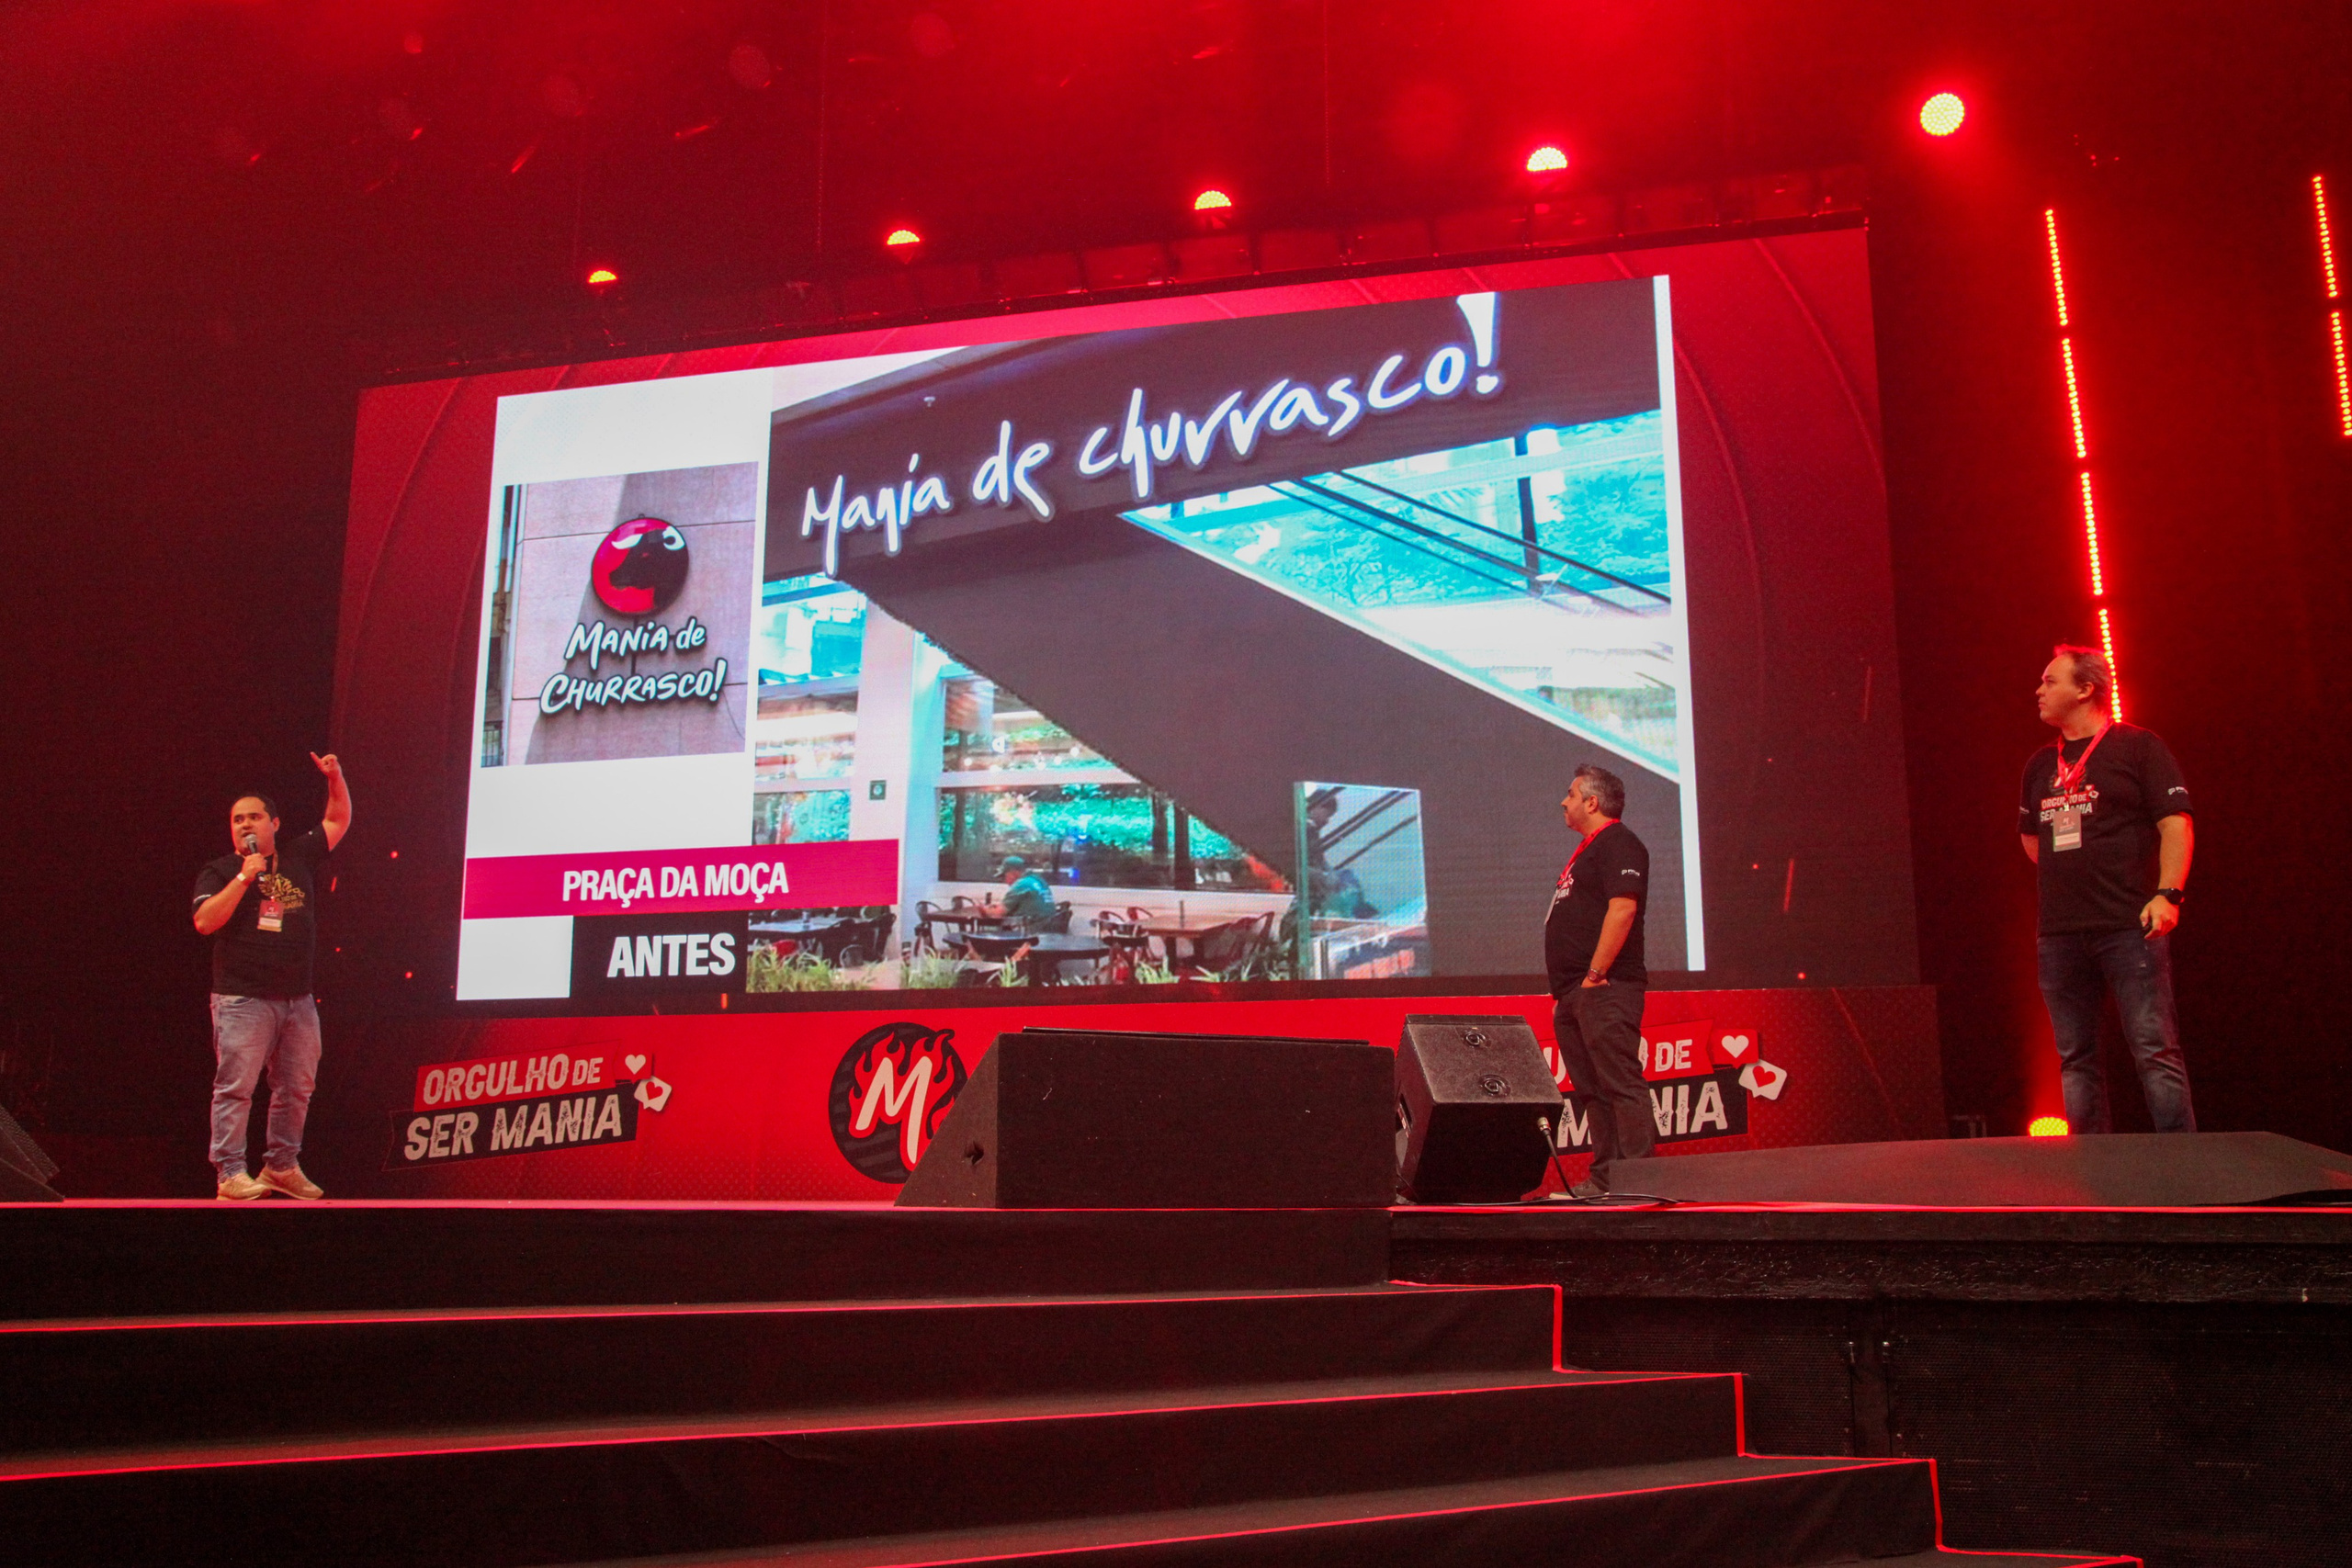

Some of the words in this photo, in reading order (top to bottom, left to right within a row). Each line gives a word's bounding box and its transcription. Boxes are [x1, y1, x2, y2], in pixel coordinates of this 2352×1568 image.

[802, 453, 951, 576] Mania
[972, 420, 1050, 517] de
[1079, 291, 1499, 498] churrasco!
[675, 617, 707, 649] de
[539, 659, 728, 714] CHURRASCO!
[562, 867, 655, 908] PRAÇA
[660, 865, 699, 898] DA
[704, 862, 789, 904] MOÇA
[606, 932, 736, 978] ANTES
[423, 1054, 570, 1105] ORGULHO
[571, 1057, 604, 1087] DE
[1655, 1039, 1693, 1073] DE
[404, 1111, 480, 1161] SER
[490, 1094, 622, 1151] MANIA
[855, 1055, 933, 1165] M
[1556, 1080, 1728, 1149] MNIA
